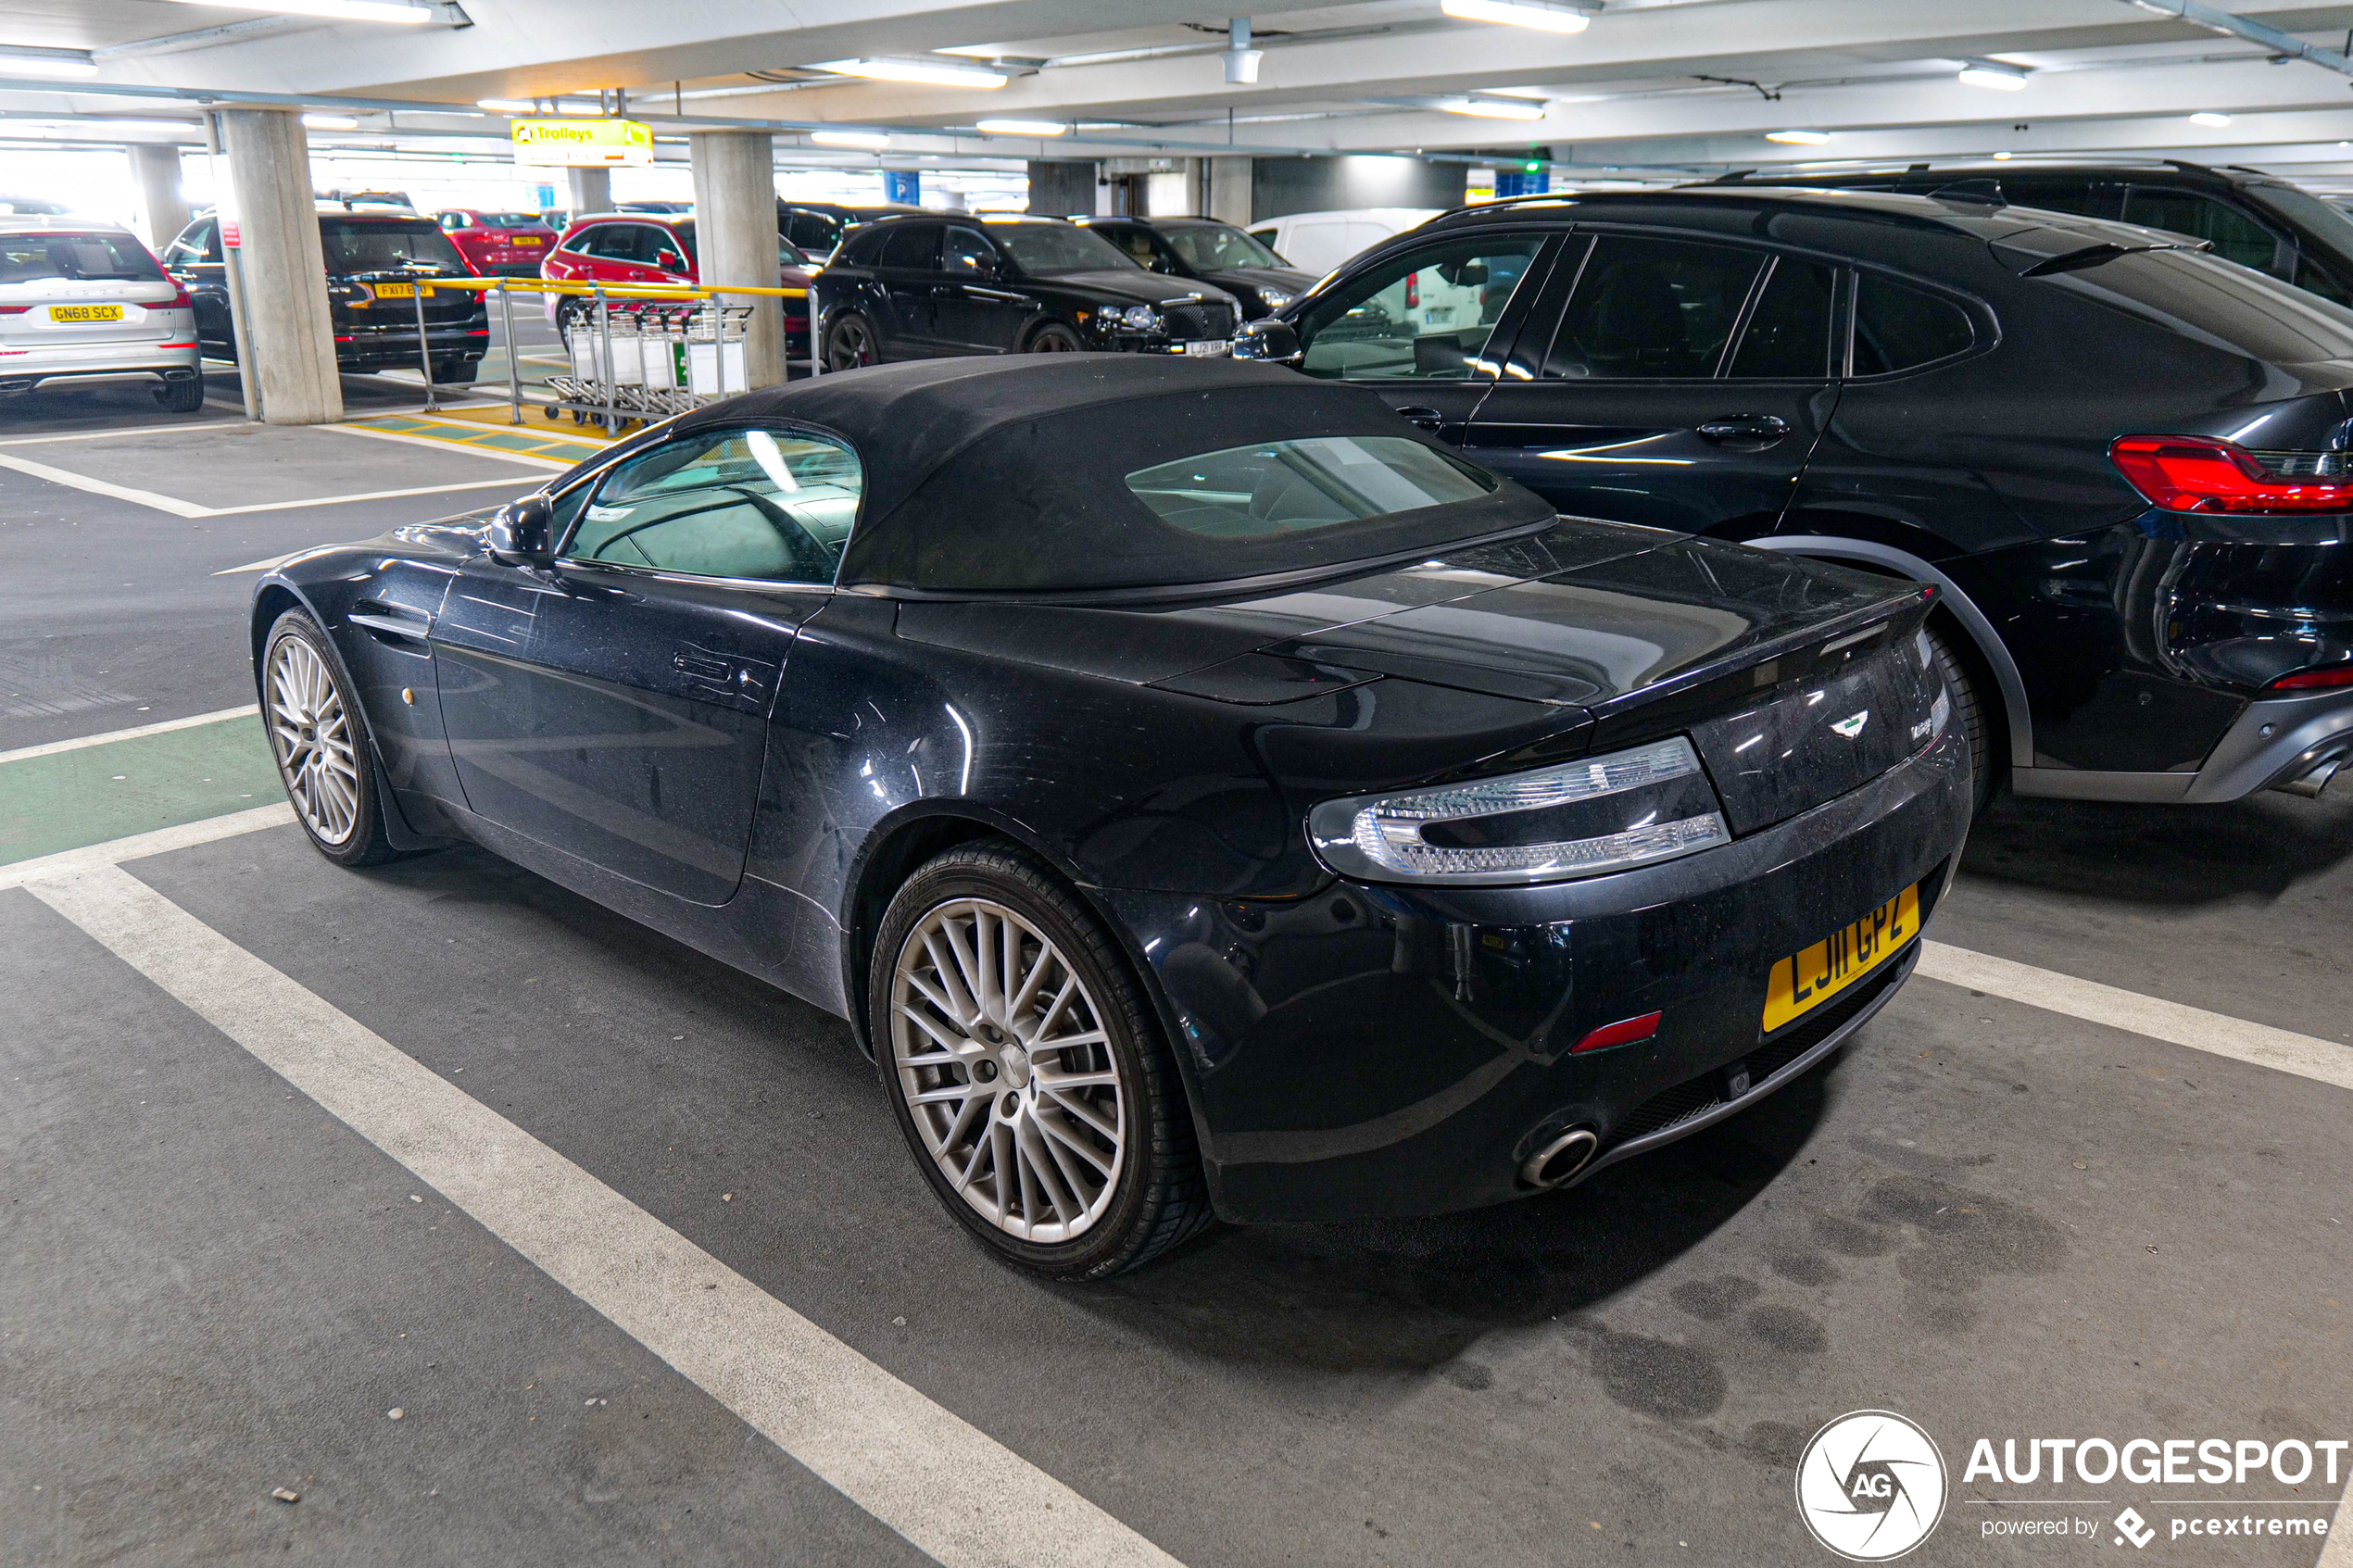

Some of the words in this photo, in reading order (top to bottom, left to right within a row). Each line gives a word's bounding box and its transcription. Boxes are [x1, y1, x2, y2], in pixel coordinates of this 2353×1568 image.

[536, 126, 593, 143] Trolleys
[897, 183, 906, 197] P
[382, 285, 404, 295] FX17
[407, 285, 427, 295] EU
[55, 307, 90, 320] GN68
[93, 306, 119, 319] SCX
[1856, 893, 1903, 963] GPZ
